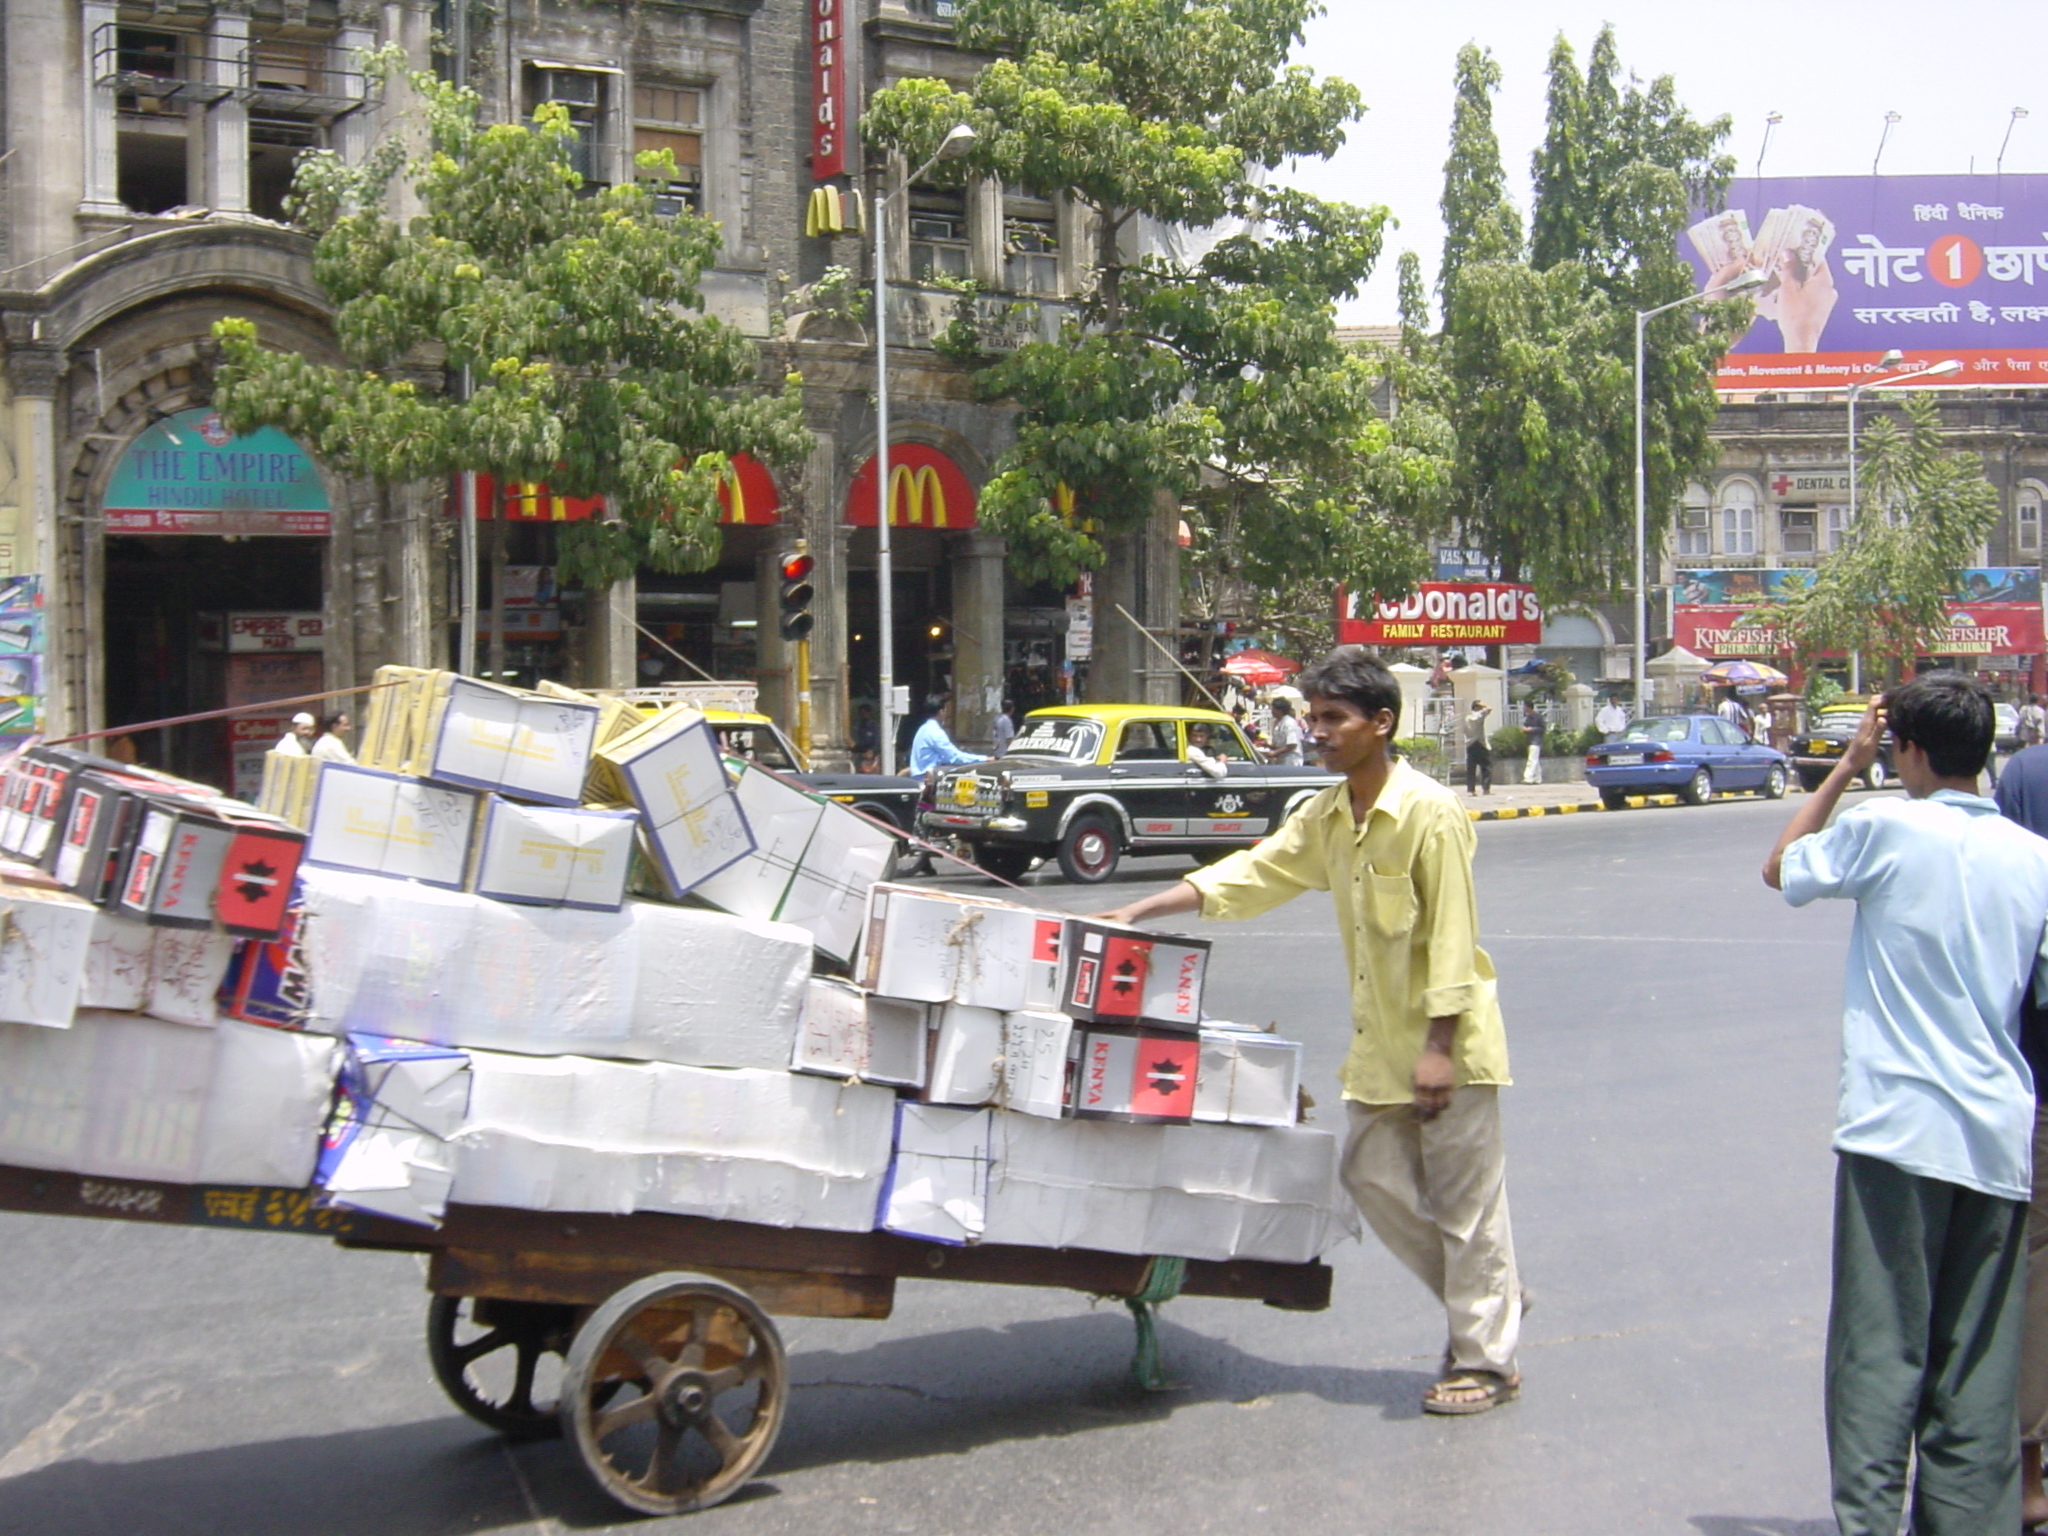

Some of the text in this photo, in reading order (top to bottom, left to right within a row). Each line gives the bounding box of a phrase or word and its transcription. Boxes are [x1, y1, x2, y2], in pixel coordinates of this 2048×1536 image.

[1841, 234, 1925, 288] नोट
[1945, 242, 1962, 280] 1
[131, 449, 302, 484] THE EMPIRE
[1797, 477, 1835, 490] DENTAL
[147, 485, 289, 509] HINDU HOTEL
[1382, 623, 1507, 639] FAMILY RESTAURANT
[1176, 953, 1199, 1015] KENYA
[1087, 1042, 1110, 1105] KENYA
